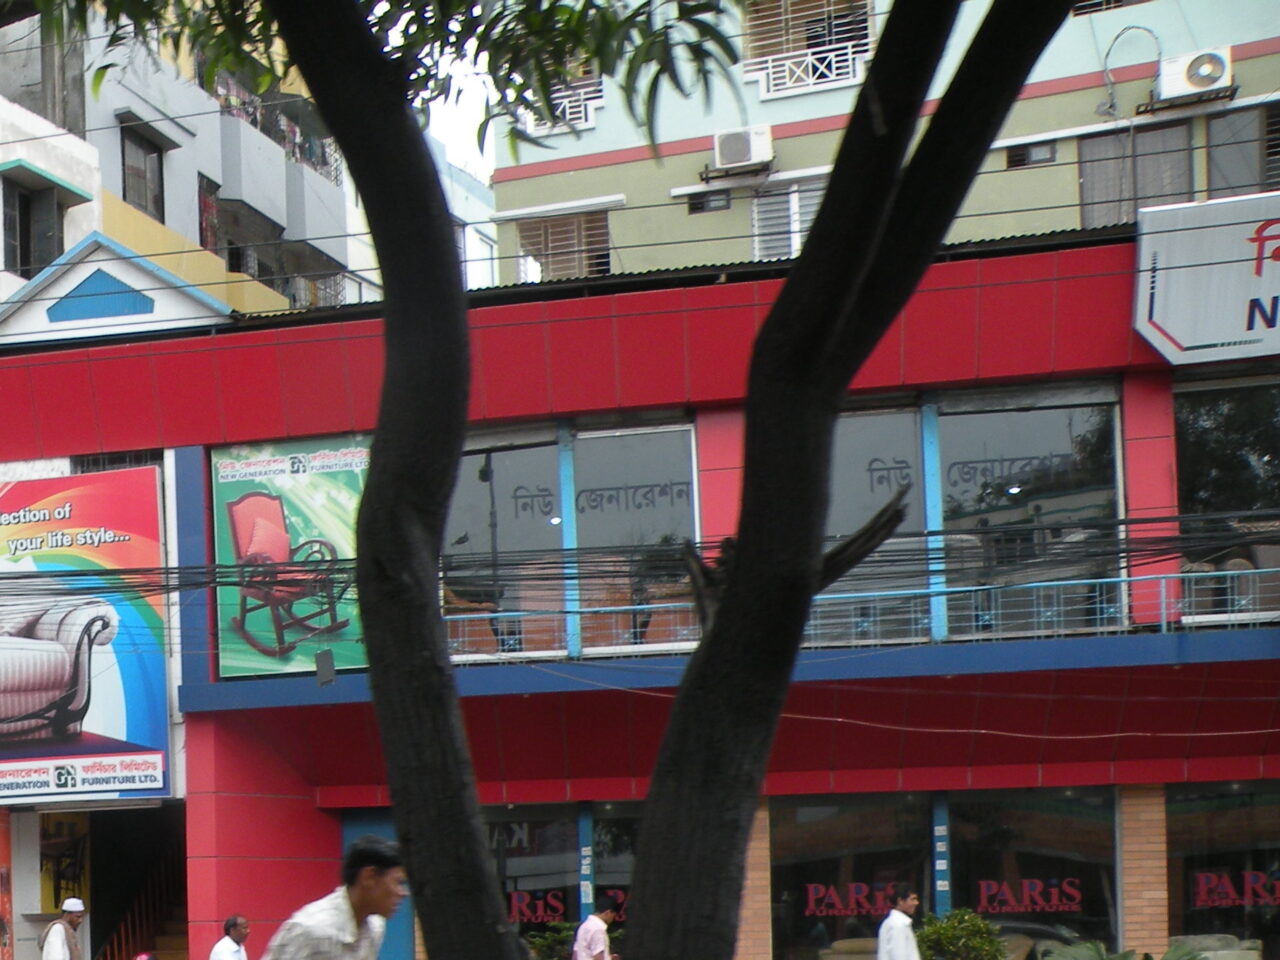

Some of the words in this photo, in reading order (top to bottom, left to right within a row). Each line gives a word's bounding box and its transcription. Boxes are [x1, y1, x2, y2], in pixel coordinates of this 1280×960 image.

[239, 469, 286, 479] GENERATION
[310, 462, 354, 472] FURNITURE
[512, 485, 554, 519] নিউ
[575, 480, 691, 513] জেনারেশন
[54, 503, 72, 519] of
[8, 537, 45, 555] your
[48, 531, 72, 548] life
[76, 527, 131, 548] style...
[81, 775, 136, 786] FURNITURE
[138, 774, 160, 784] LTD.
